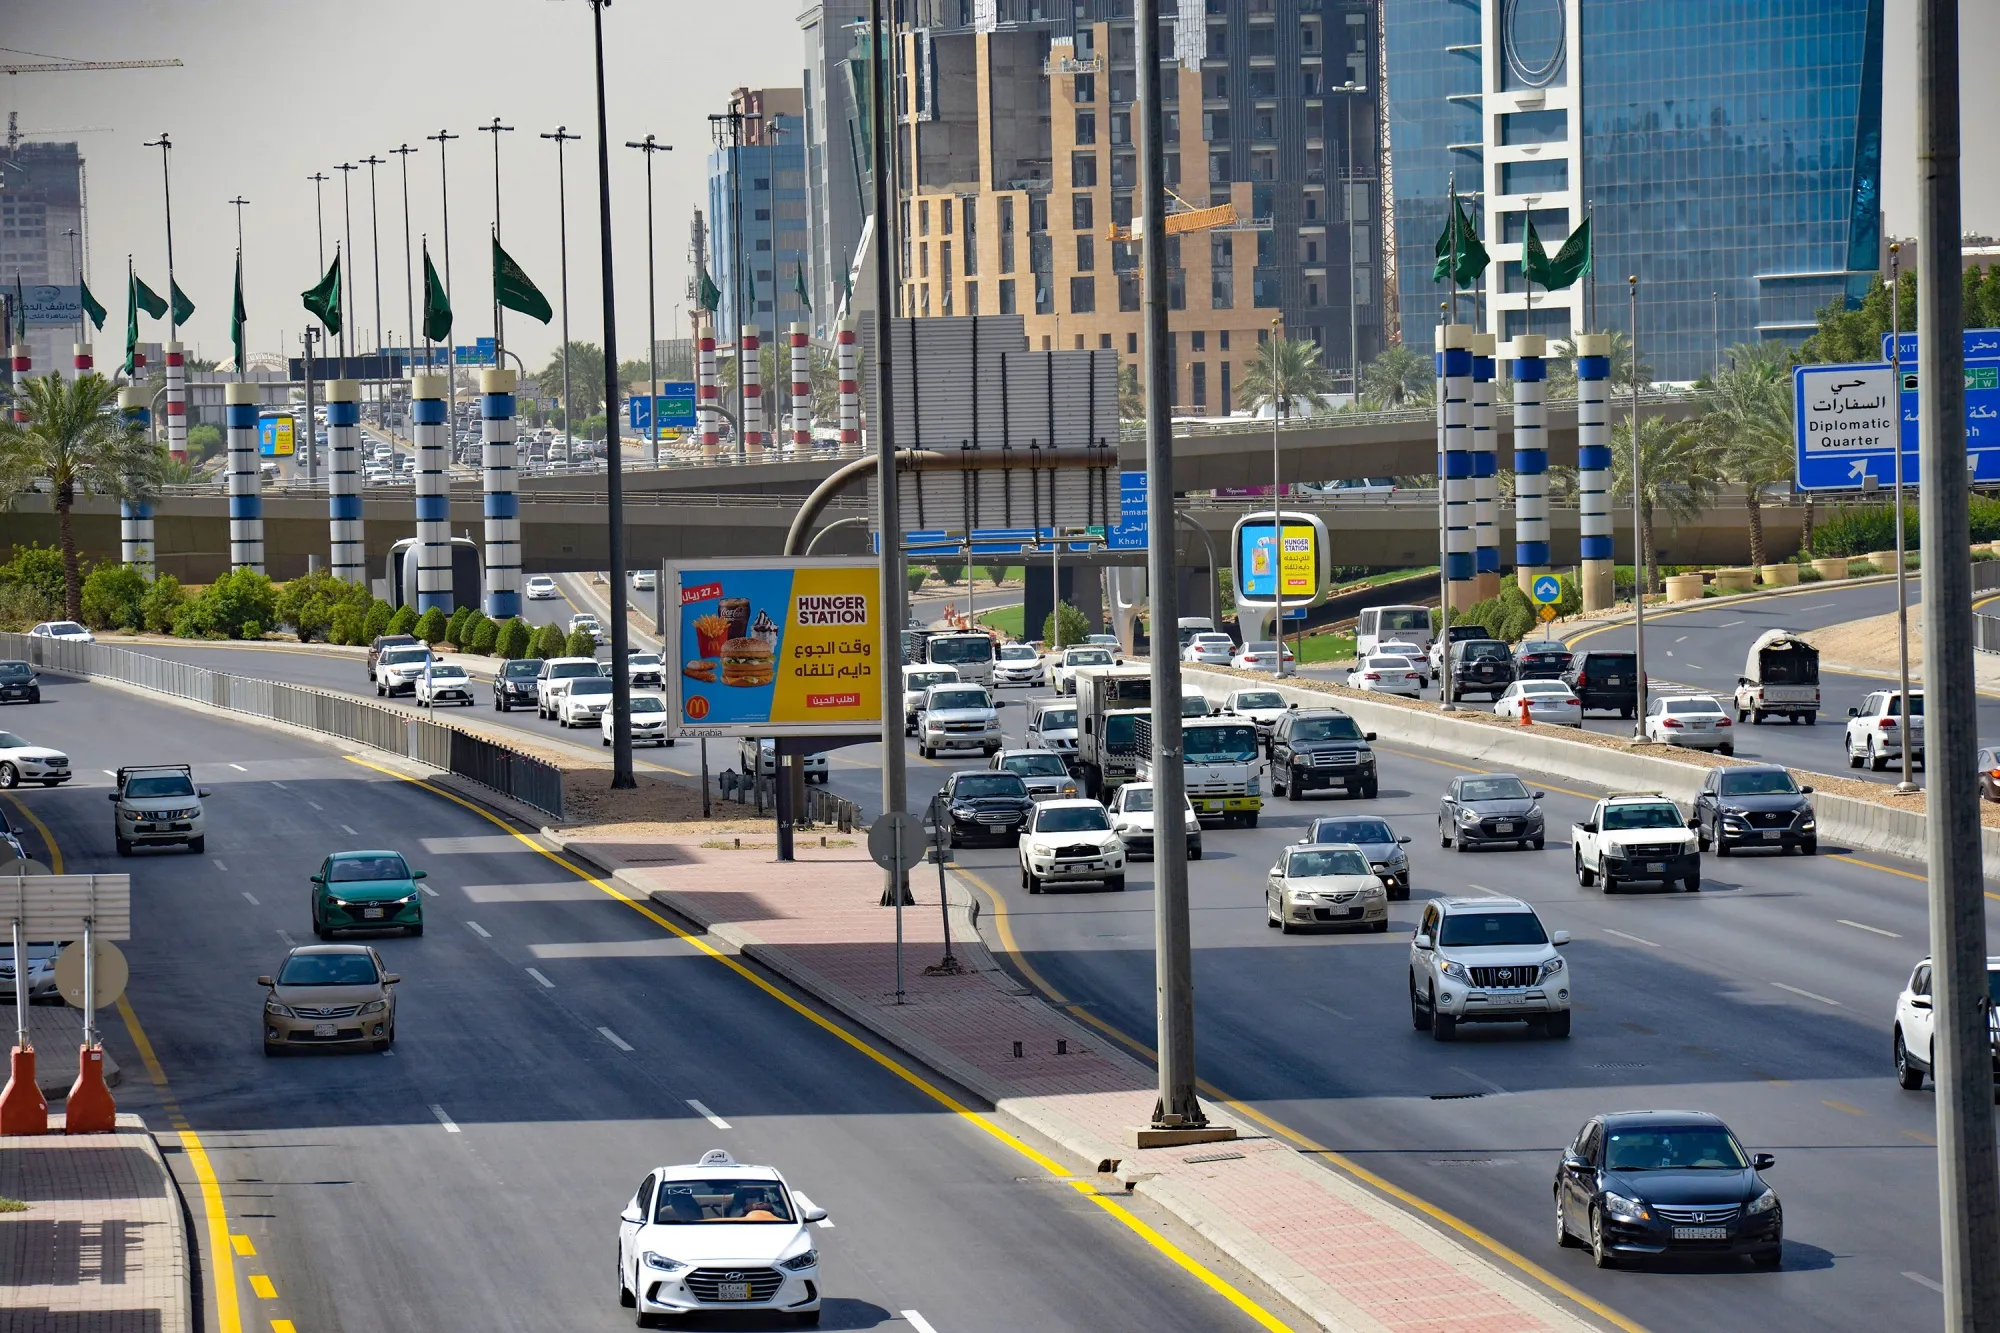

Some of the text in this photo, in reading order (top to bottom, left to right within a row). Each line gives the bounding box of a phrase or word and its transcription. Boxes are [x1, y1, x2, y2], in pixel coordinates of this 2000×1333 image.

[1892, 344, 1918, 353] XIT
[1830, 379, 1866, 395] حي
[1983, 379, 1992, 387] W
[1812, 396, 1886, 414] السفارات
[1969, 405, 1997, 419] مكة
[1809, 418, 1891, 433] Diplomatic
[1821, 436, 1880, 448] Quarter
[1118, 538, 1142, 546] Kharj
[682, 590, 700, 602] ريال
[700, 588, 711, 598] 27
[799, 597, 865, 610] HUNGER
[799, 610, 866, 624] STATION
[795, 639, 871, 659] وقت الجوع
[795, 662, 871, 679] دايم تلقاه
[812, 695, 855, 706] اطلب الحين
[697, 729, 722, 737] arabia
